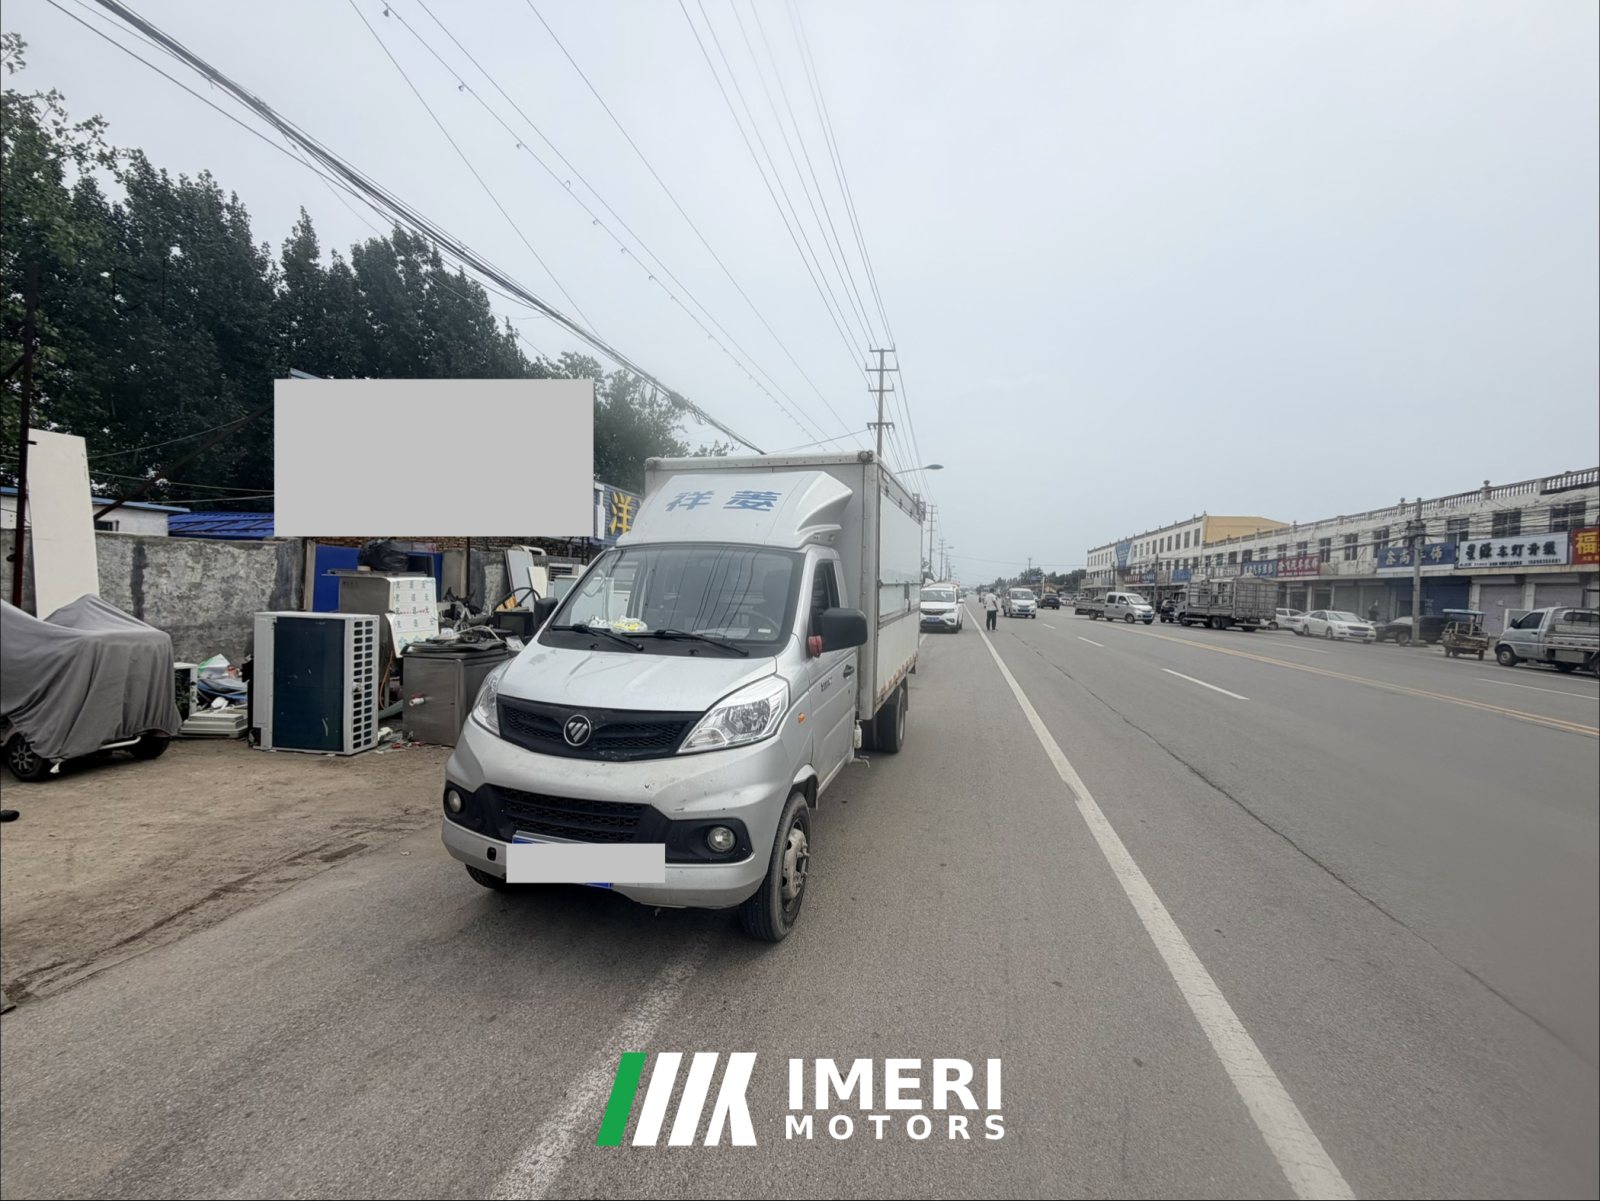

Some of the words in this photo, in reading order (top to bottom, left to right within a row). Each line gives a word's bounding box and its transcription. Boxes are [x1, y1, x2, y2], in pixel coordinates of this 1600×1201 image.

[665, 490, 782, 512] 祥菱
[609, 491, 633, 536] 洋
[1575, 532, 1598, 554] 福
